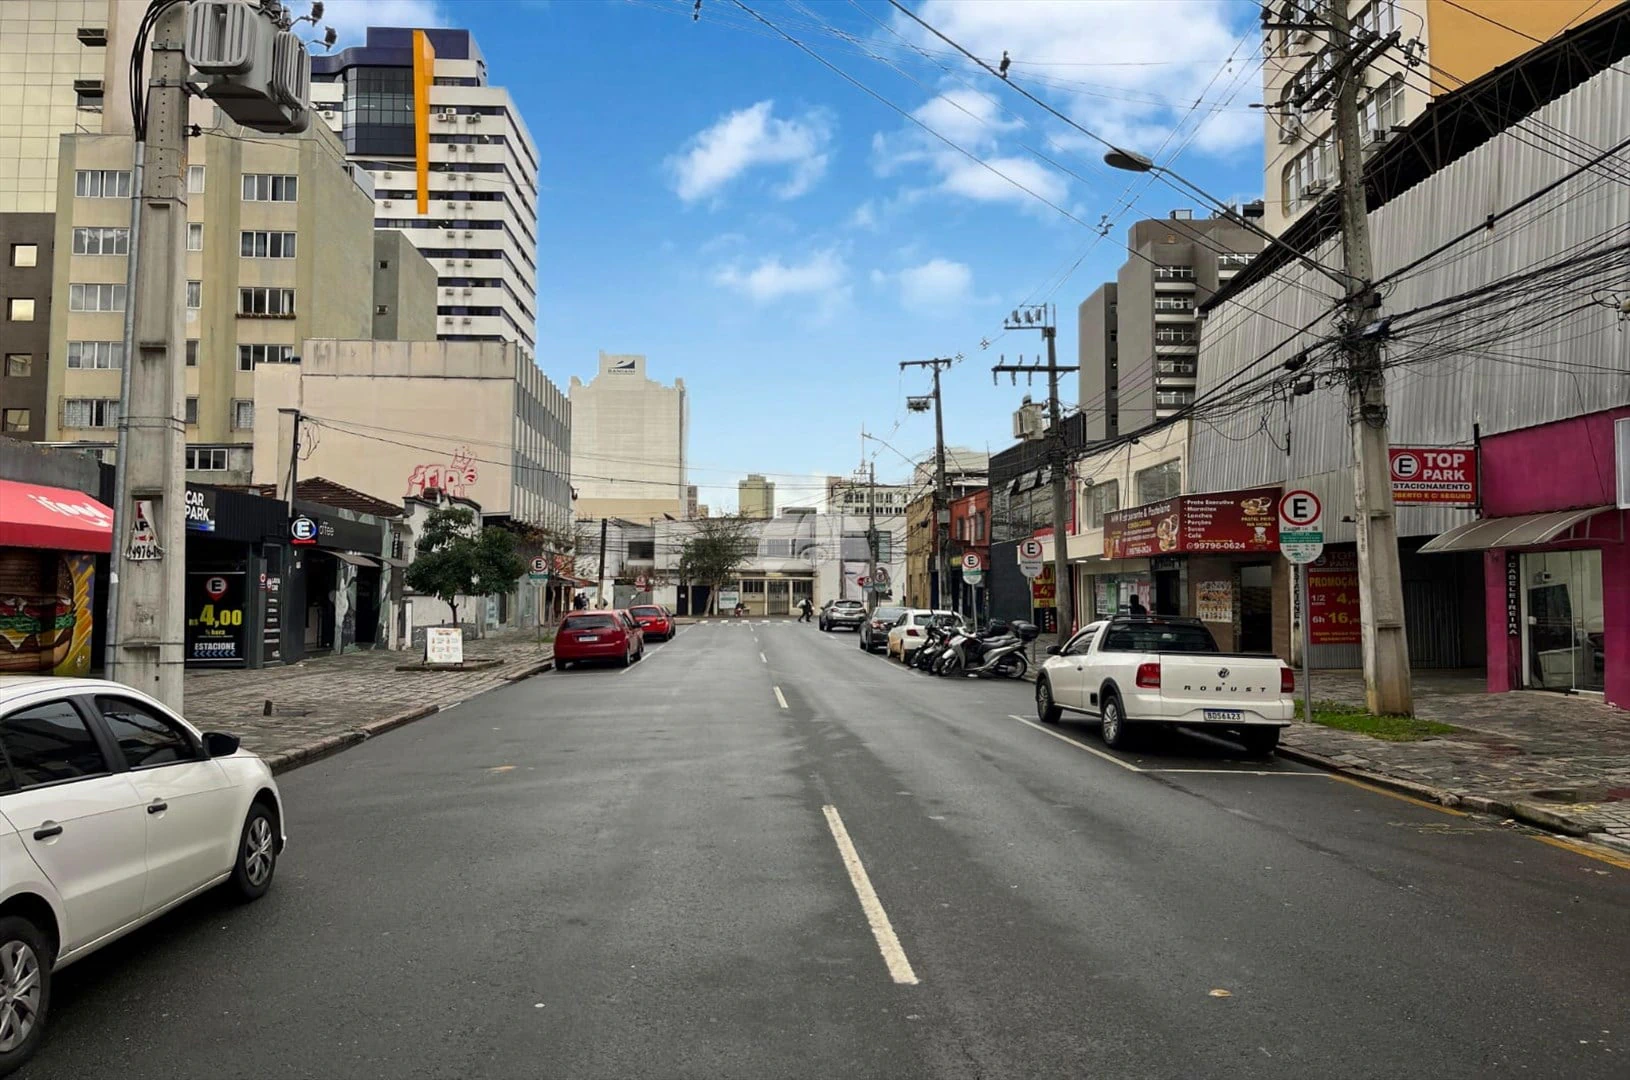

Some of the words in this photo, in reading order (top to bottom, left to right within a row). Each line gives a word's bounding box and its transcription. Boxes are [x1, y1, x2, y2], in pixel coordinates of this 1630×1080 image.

[1398, 458, 1412, 474] E
[1424, 453, 1465, 468] TOP
[1423, 469, 1465, 481] PARK
[185, 490, 204, 507] CAR
[184, 506, 210, 521] PARK
[1293, 498, 1308, 518] E
[296, 521, 310, 537] E
[1028, 543, 1035, 554] E
[535, 560, 542, 568] E
[968, 556, 974, 565] E
[211, 580, 222, 592] E
[1508, 562, 1517, 635] CABELEIREIRA
[200, 604, 242, 628] 4,00
